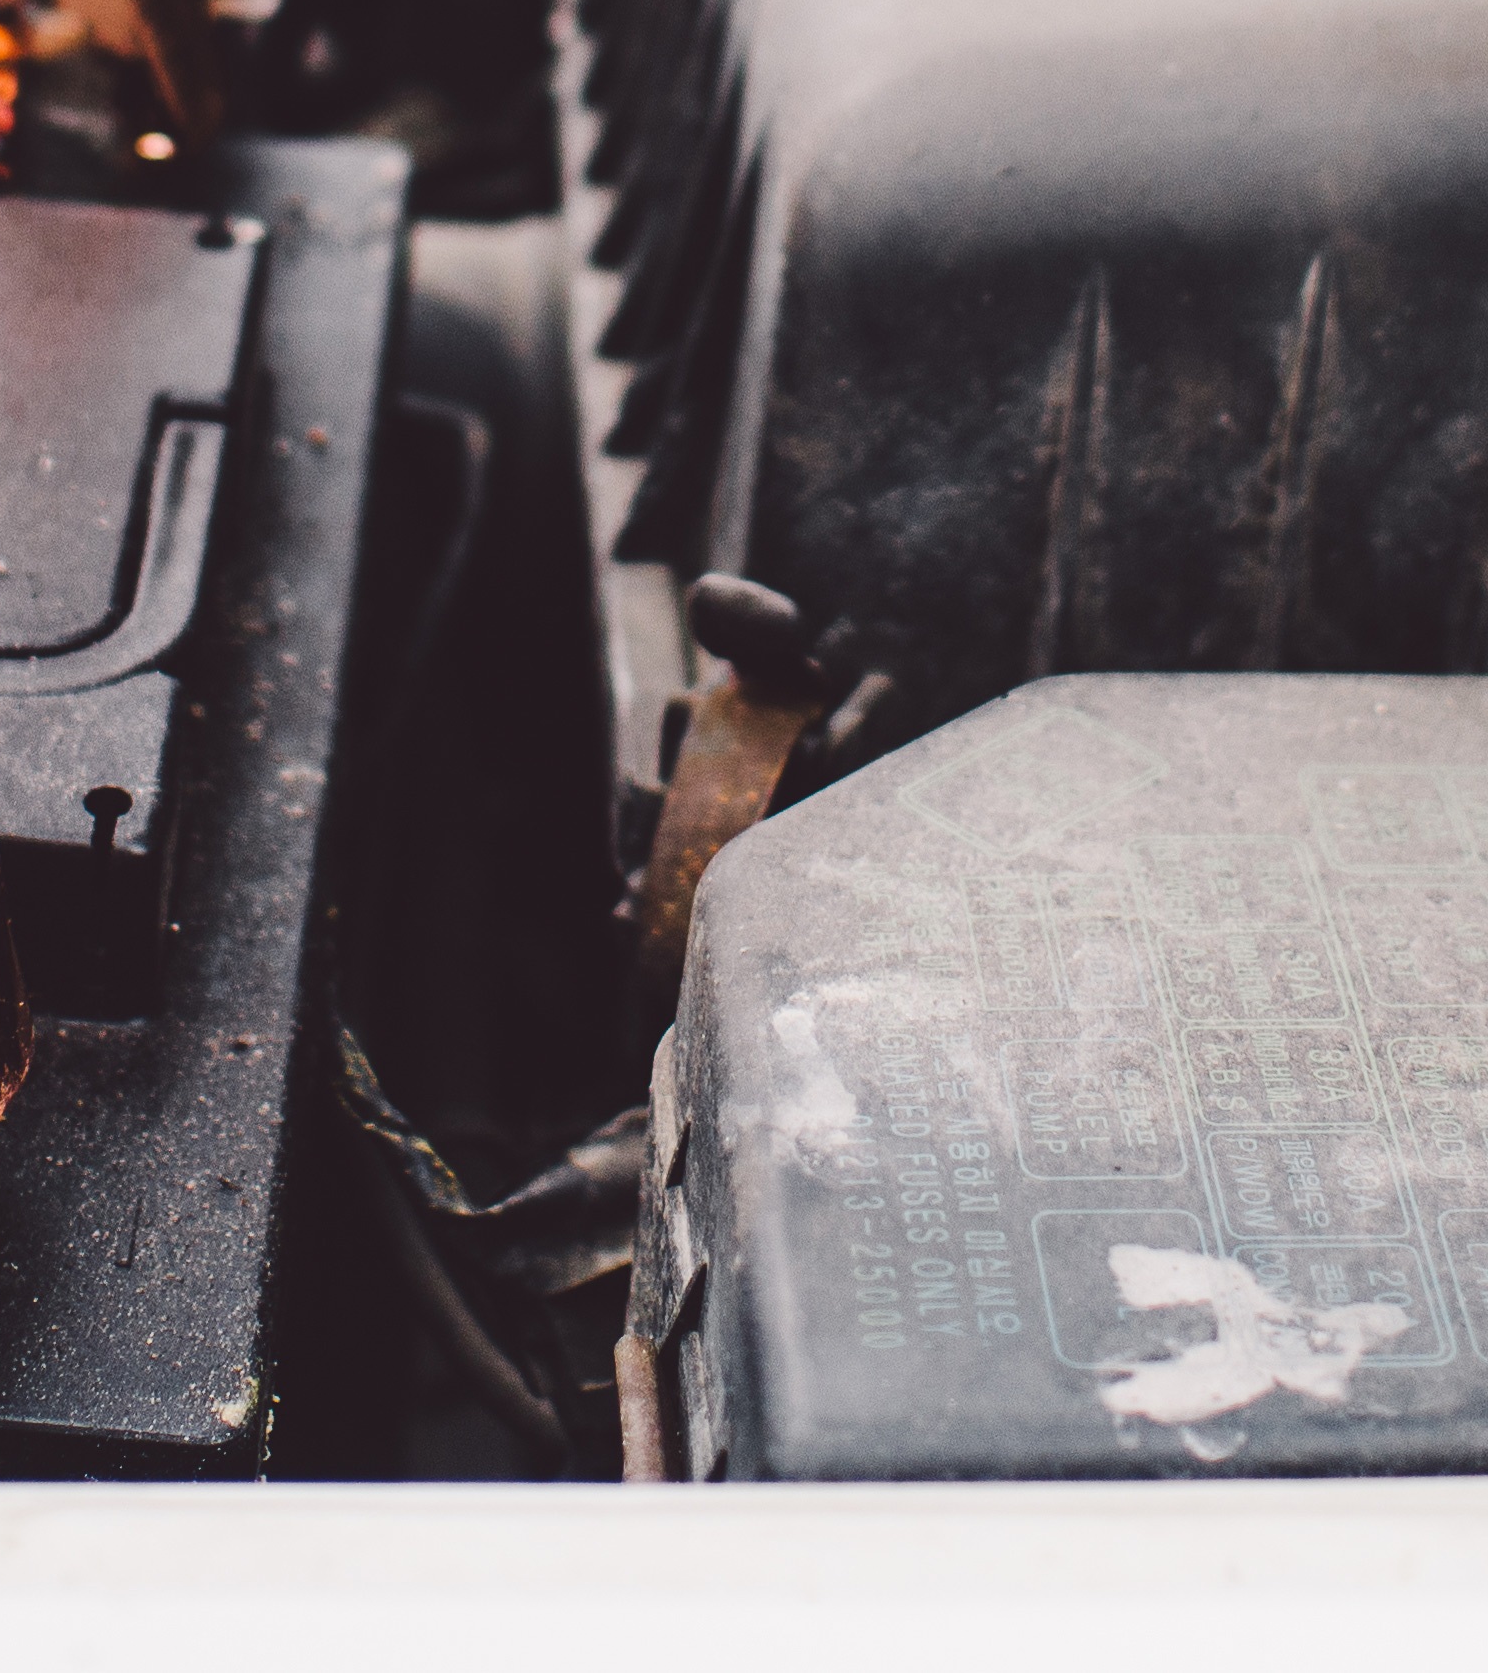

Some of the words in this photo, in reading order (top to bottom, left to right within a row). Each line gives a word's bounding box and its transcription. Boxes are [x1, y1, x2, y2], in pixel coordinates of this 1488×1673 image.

[1278, 949, 1330, 1001] 30A
[1025, 1071, 1068, 1155] PUMP
[1068, 1073, 1112, 1151] FUEL
[1307, 1048, 1357, 1103] 30A
[901, 1152, 948, 1244] FUSES
[946, 1118, 998, 1213] 사용하지
[1224, 1138, 1277, 1231] P/WDW
[1335, 1154, 1390, 1214] 30A
